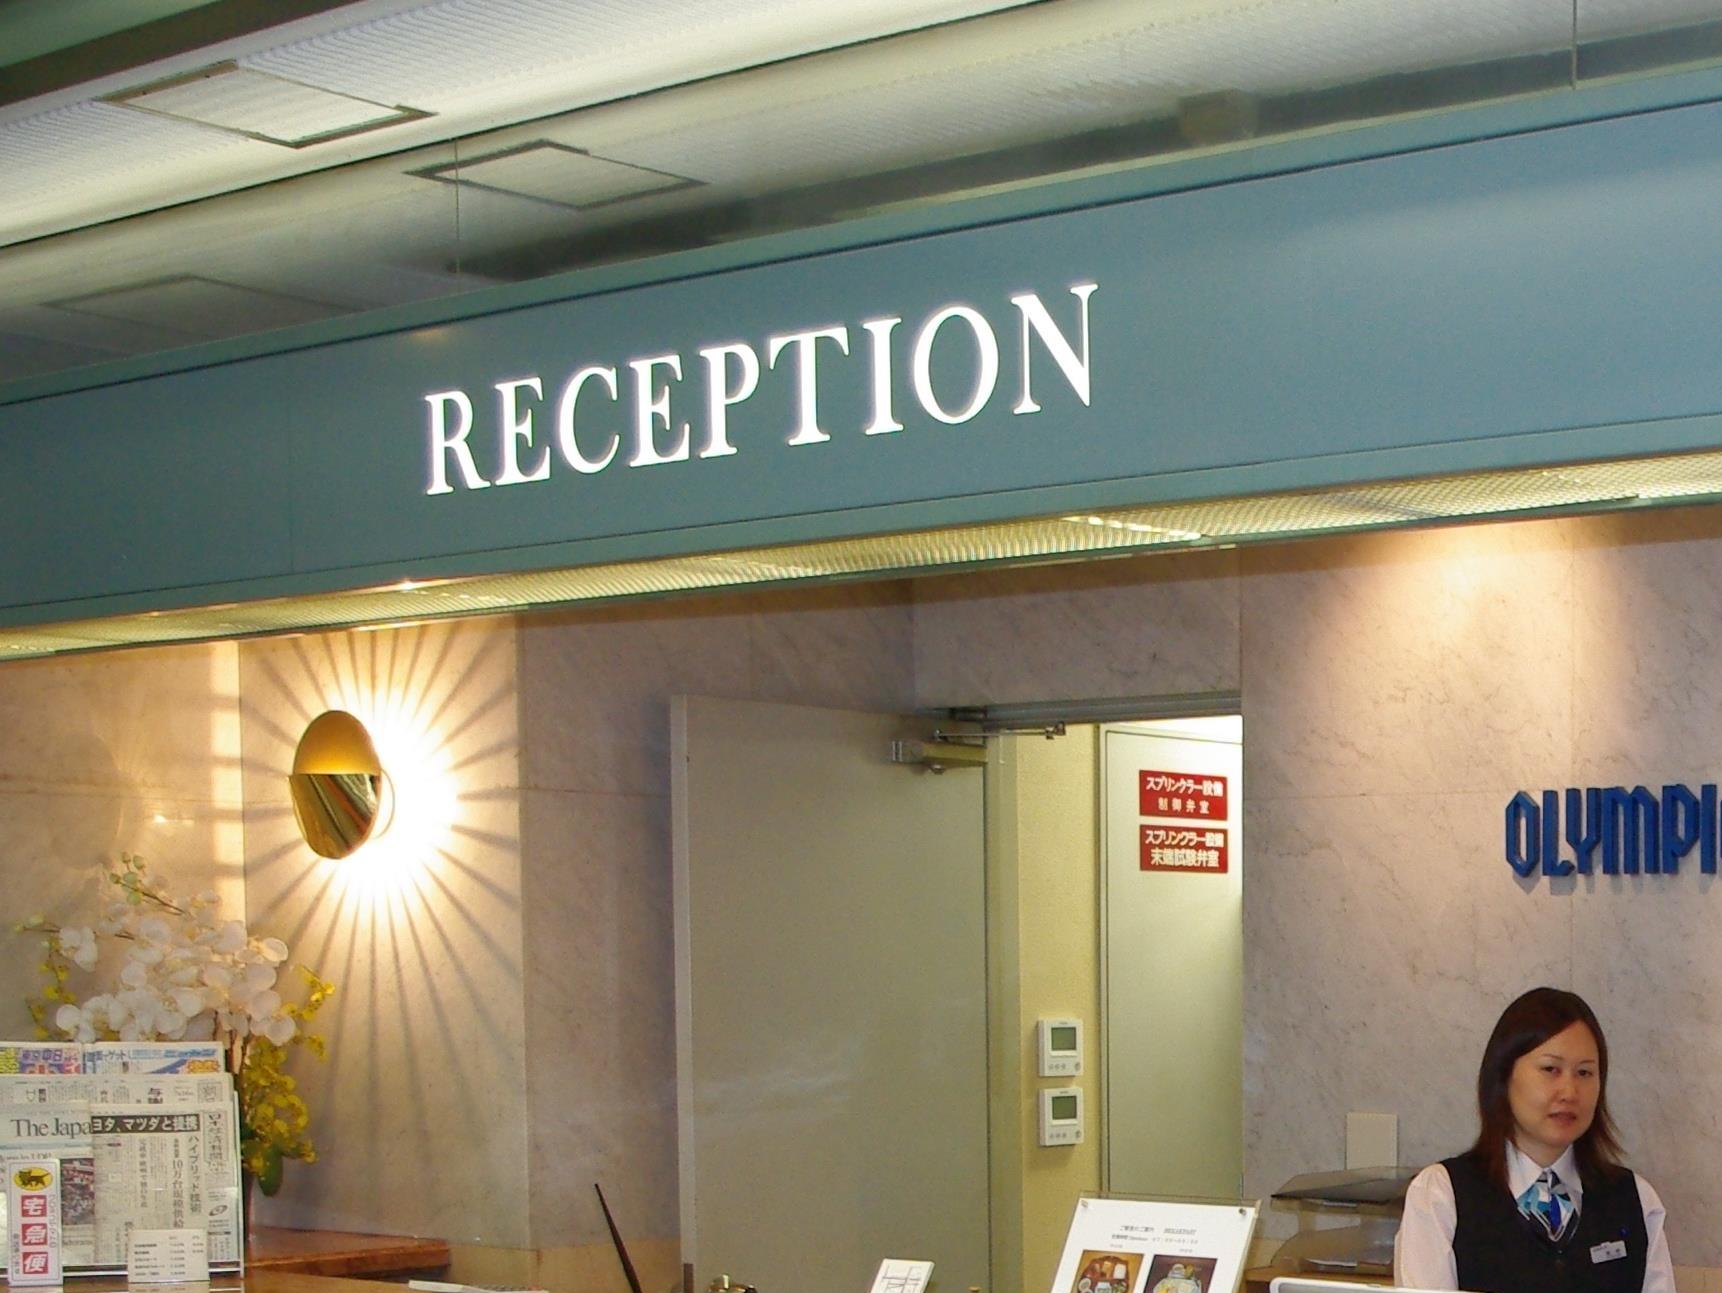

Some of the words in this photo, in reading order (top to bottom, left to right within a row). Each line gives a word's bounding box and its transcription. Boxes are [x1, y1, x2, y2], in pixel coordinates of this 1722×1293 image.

[425, 283, 1098, 495] RECEPTION
[11, 1118, 49, 1138] The
[22, 1196, 48, 1273] 宅急便
